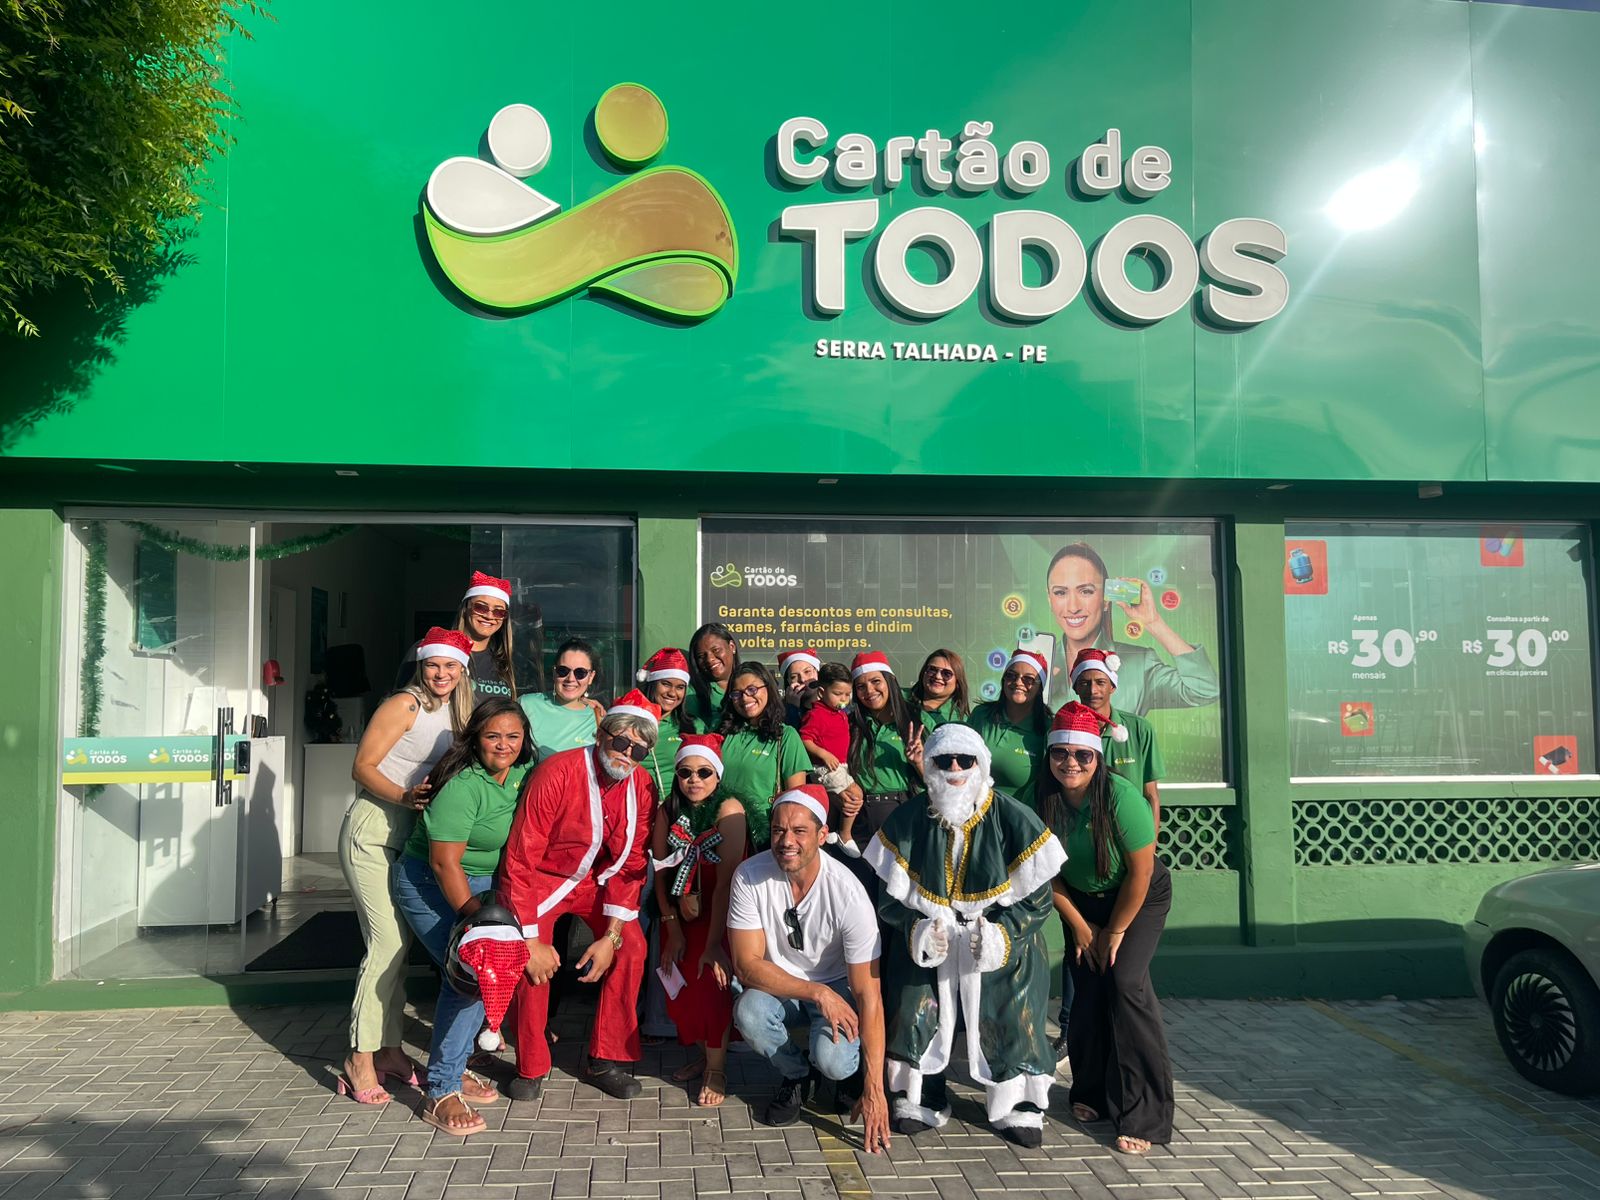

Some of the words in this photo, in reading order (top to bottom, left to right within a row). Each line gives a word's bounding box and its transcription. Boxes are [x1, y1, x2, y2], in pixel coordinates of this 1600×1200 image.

[777, 116, 1051, 193] Cartão
[1081, 127, 1172, 197] de
[780, 198, 1290, 324] TODOS
[815, 339, 886, 359] SERRA
[893, 342, 998, 361] TALHADA
[1022, 345, 1048, 362] PE
[744, 566, 773, 574] Cartão
[774, 566, 785, 574] de
[744, 574, 798, 587] TODOS
[718, 605, 775, 618] Garanta
[778, 605, 852, 618] descontos
[855, 608, 877, 618] em
[880, 605, 953, 619] consultas,
[721, 622, 777, 635] xames,
[780, 620, 850, 633] farmácias
[854, 623, 862, 633] e
[866, 620, 913, 633] dindim
[739, 636, 775, 648] volta
[779, 638, 804, 648] nas
[807, 638, 872, 650] compras.
[1328, 640, 1349, 655] R$
[1462, 640, 1483, 654] R$
[1352, 671, 1386, 680] mensais
[477, 683, 511, 696] TODOS
[89, 755, 128, 764] TODOS
[172, 754, 209, 763] TODOS
